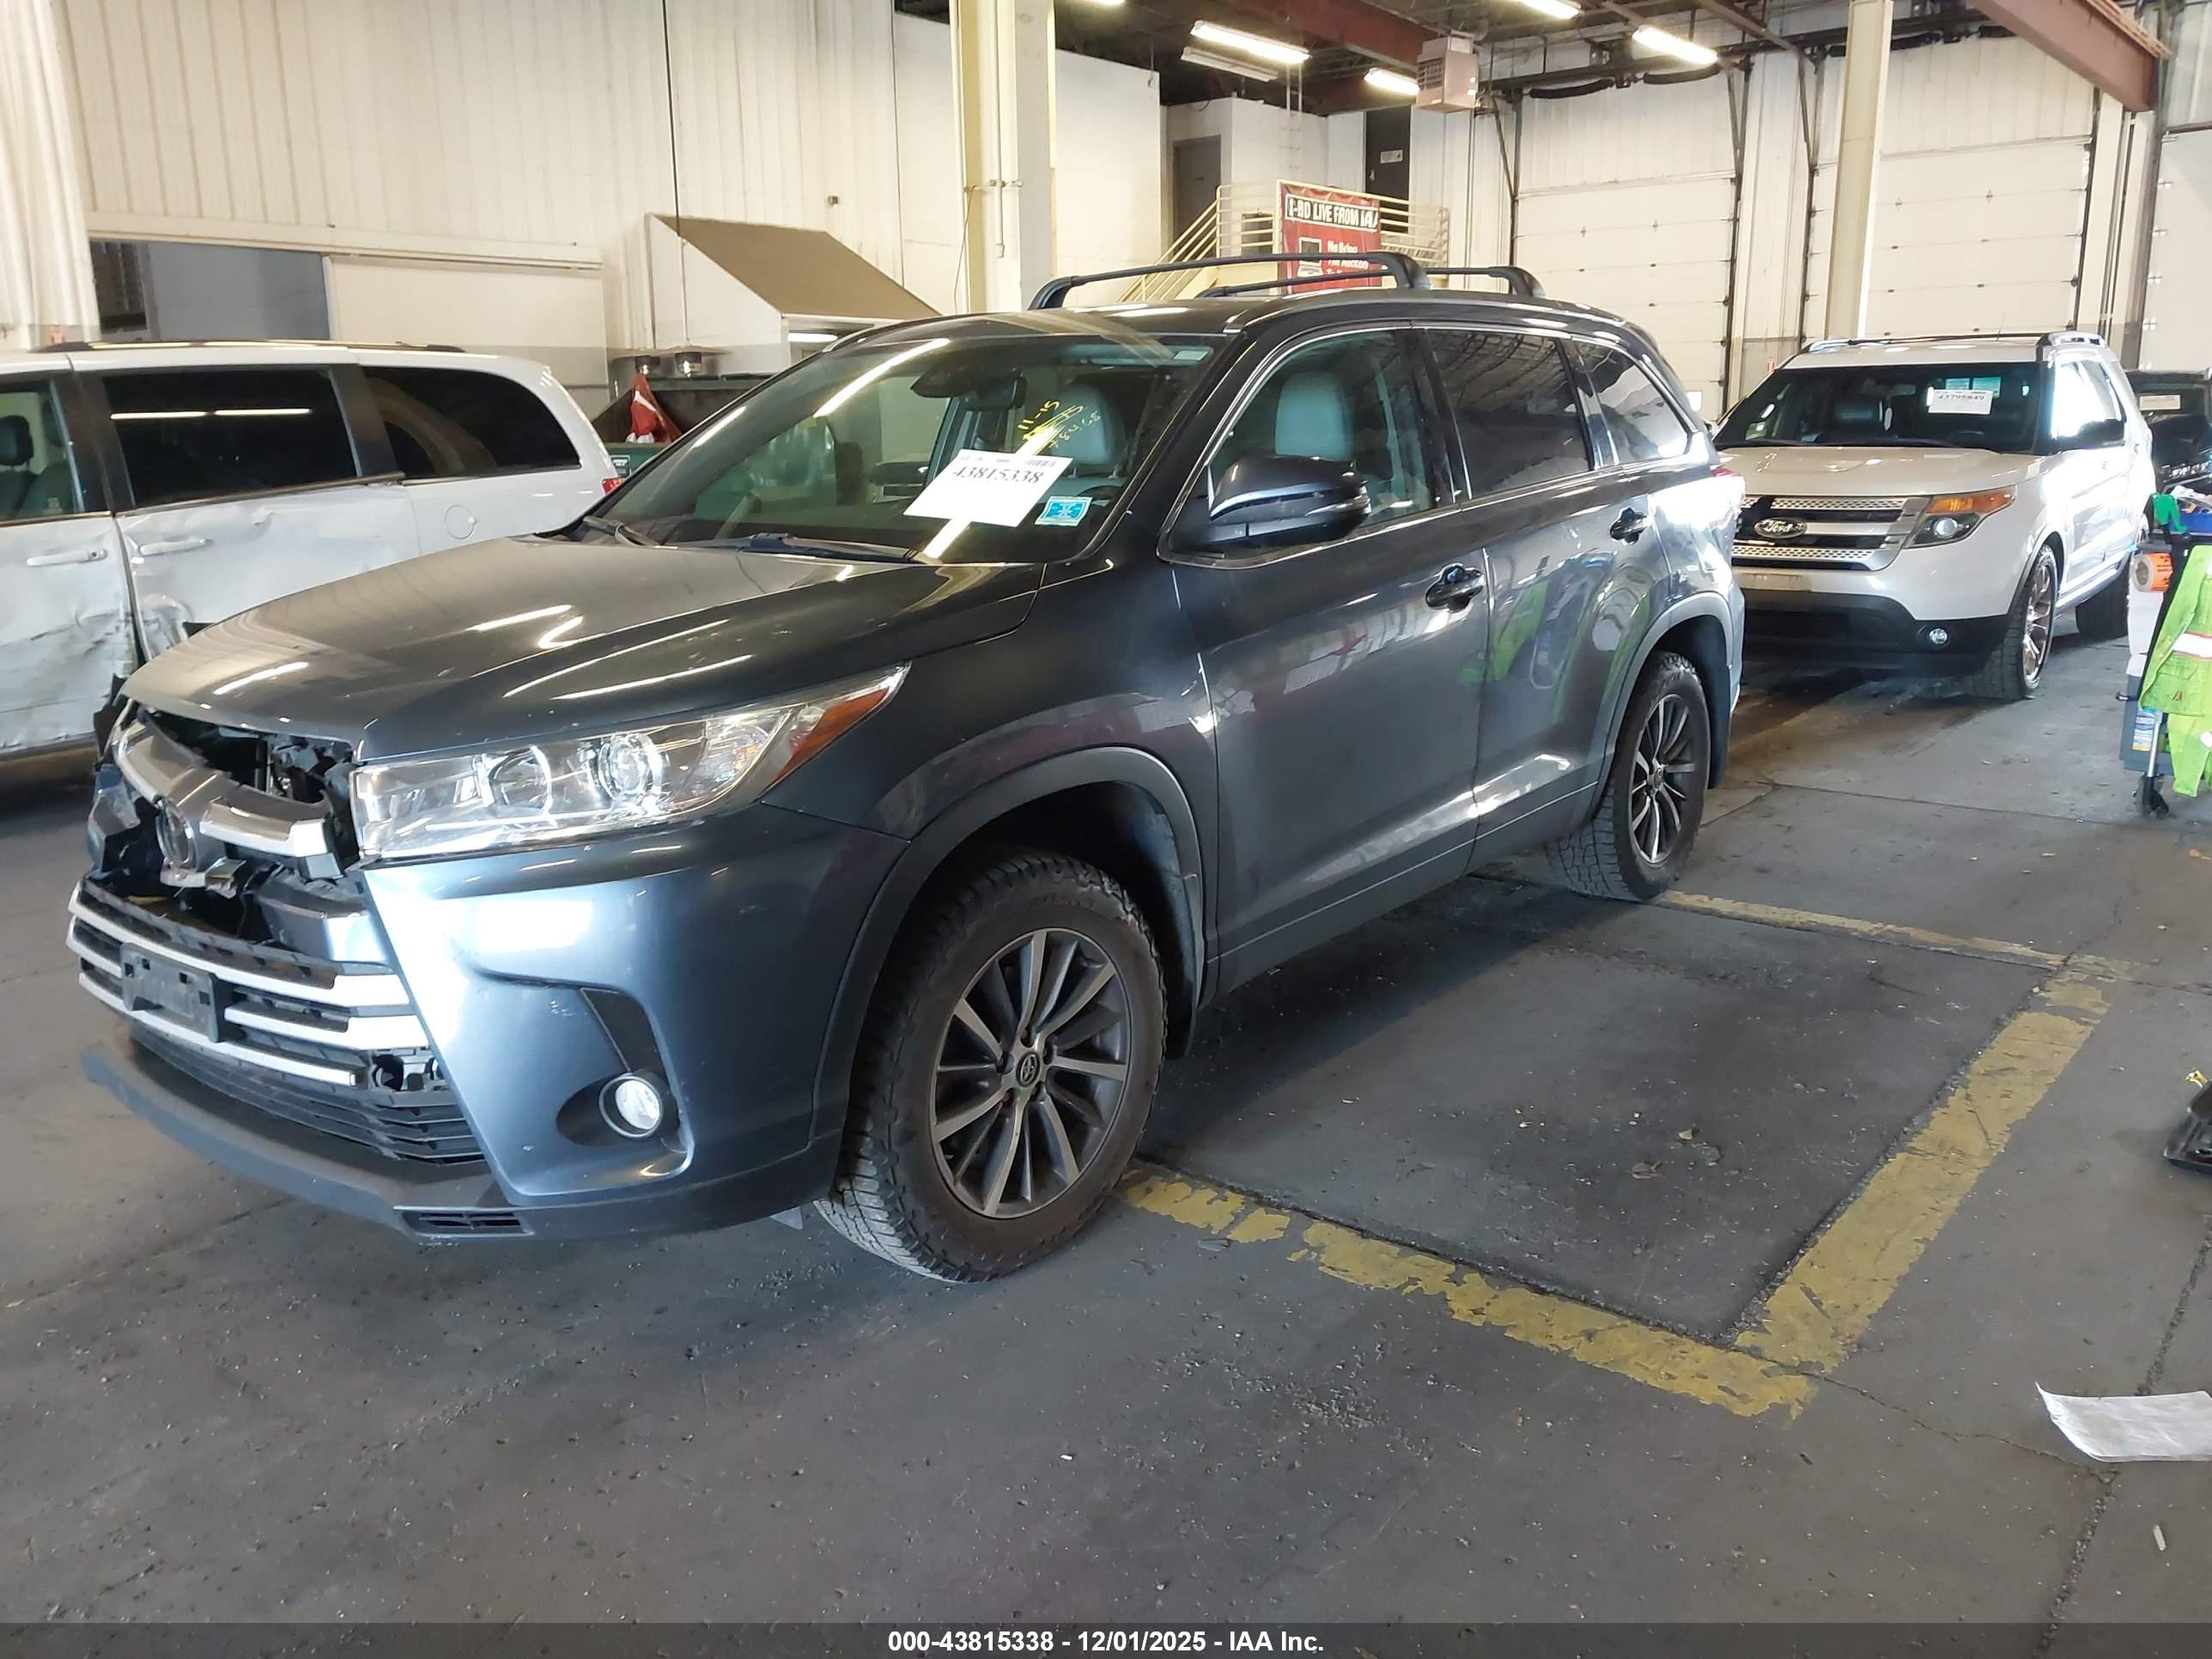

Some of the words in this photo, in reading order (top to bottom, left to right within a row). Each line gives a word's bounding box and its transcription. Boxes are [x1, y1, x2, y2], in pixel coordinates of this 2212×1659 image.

[1313, 203, 1333, 222] LIVE
[1334, 206, 1359, 226] FROM
[952, 465, 1044, 483] 43815338
[1759, 519, 1802, 533] Ford
